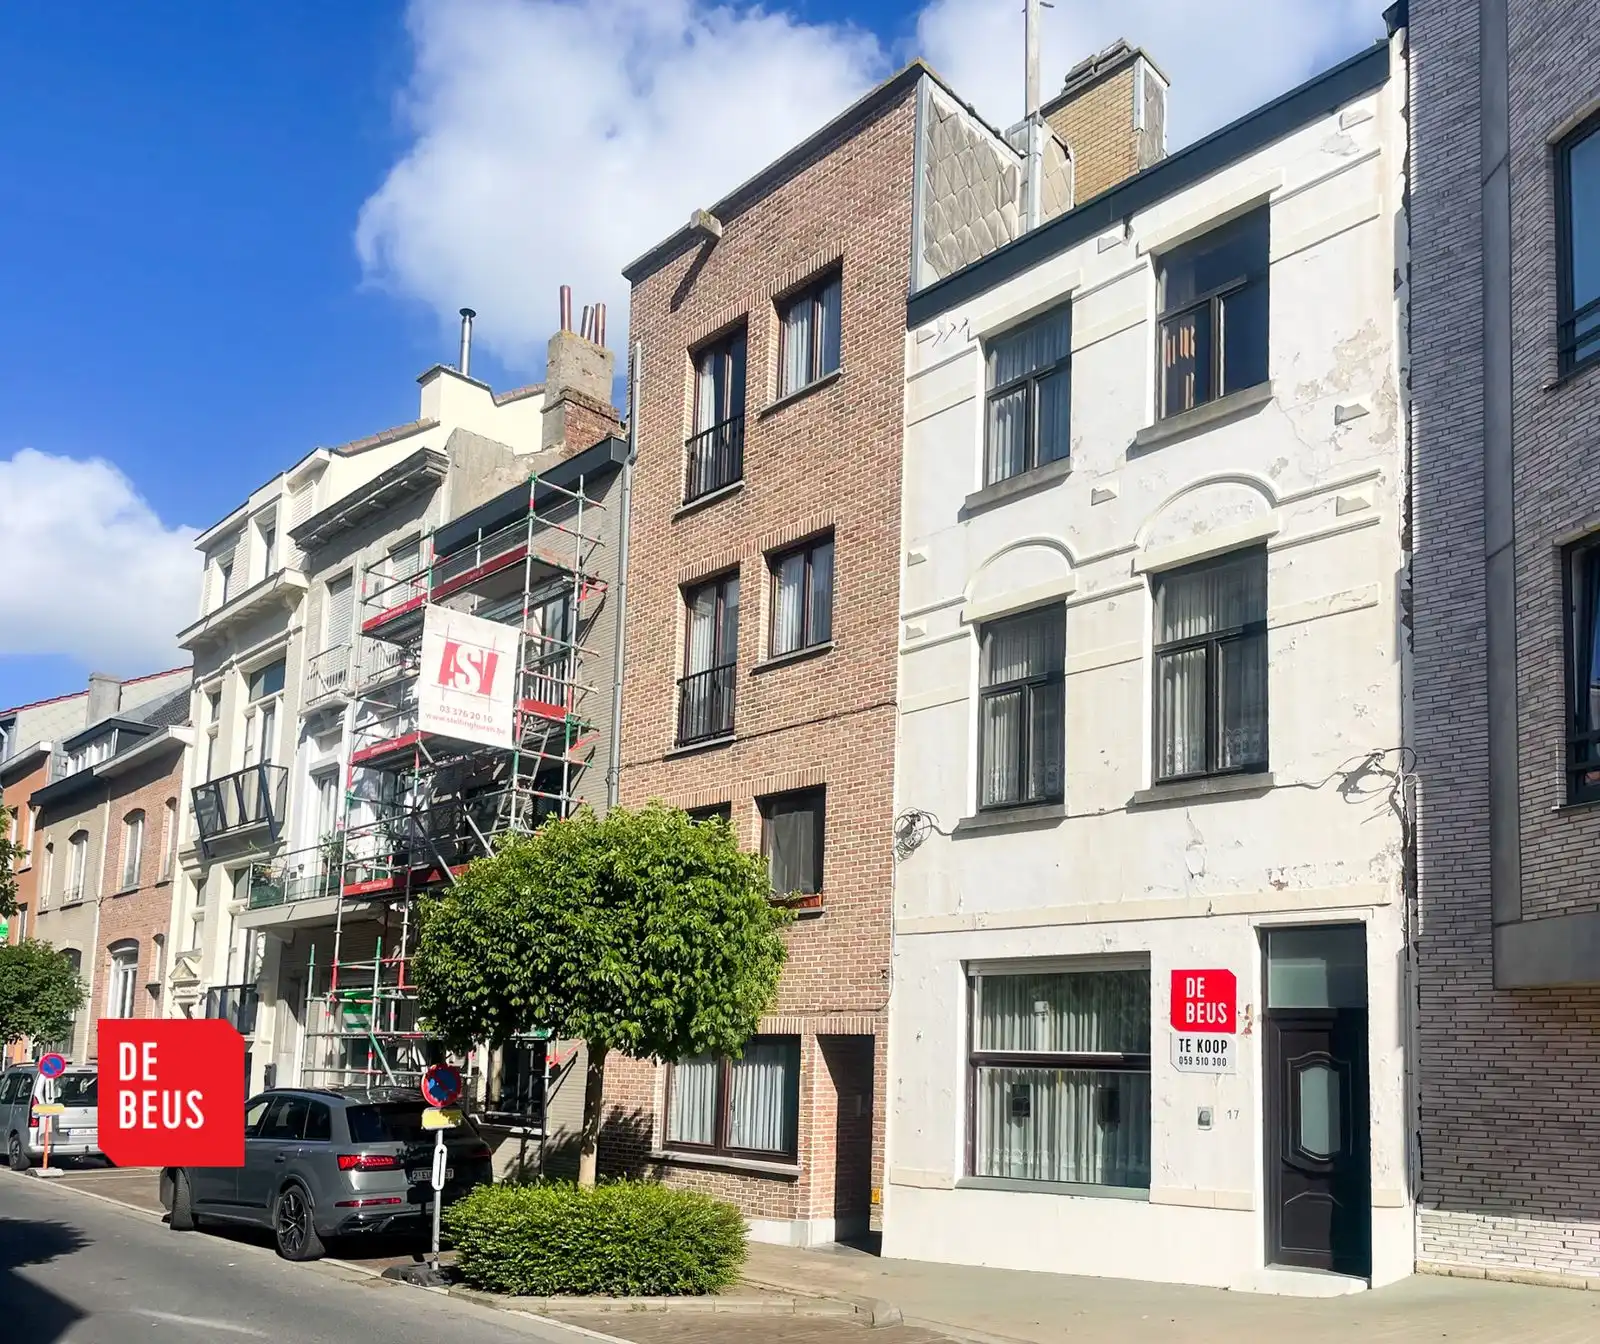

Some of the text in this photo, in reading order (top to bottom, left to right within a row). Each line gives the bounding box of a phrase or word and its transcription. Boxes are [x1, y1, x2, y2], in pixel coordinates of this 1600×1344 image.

[440, 705, 450, 713] 03
[484, 714, 493, 723] 10
[1186, 977, 1205, 998] DE
[1186, 1002, 1228, 1023] BEUS
[1179, 1039, 1228, 1054] TE KOOP
[1179, 1056, 1193, 1066] 059
[1196, 1056, 1209, 1066] 510
[1227, 1109, 1239, 1120] 17
